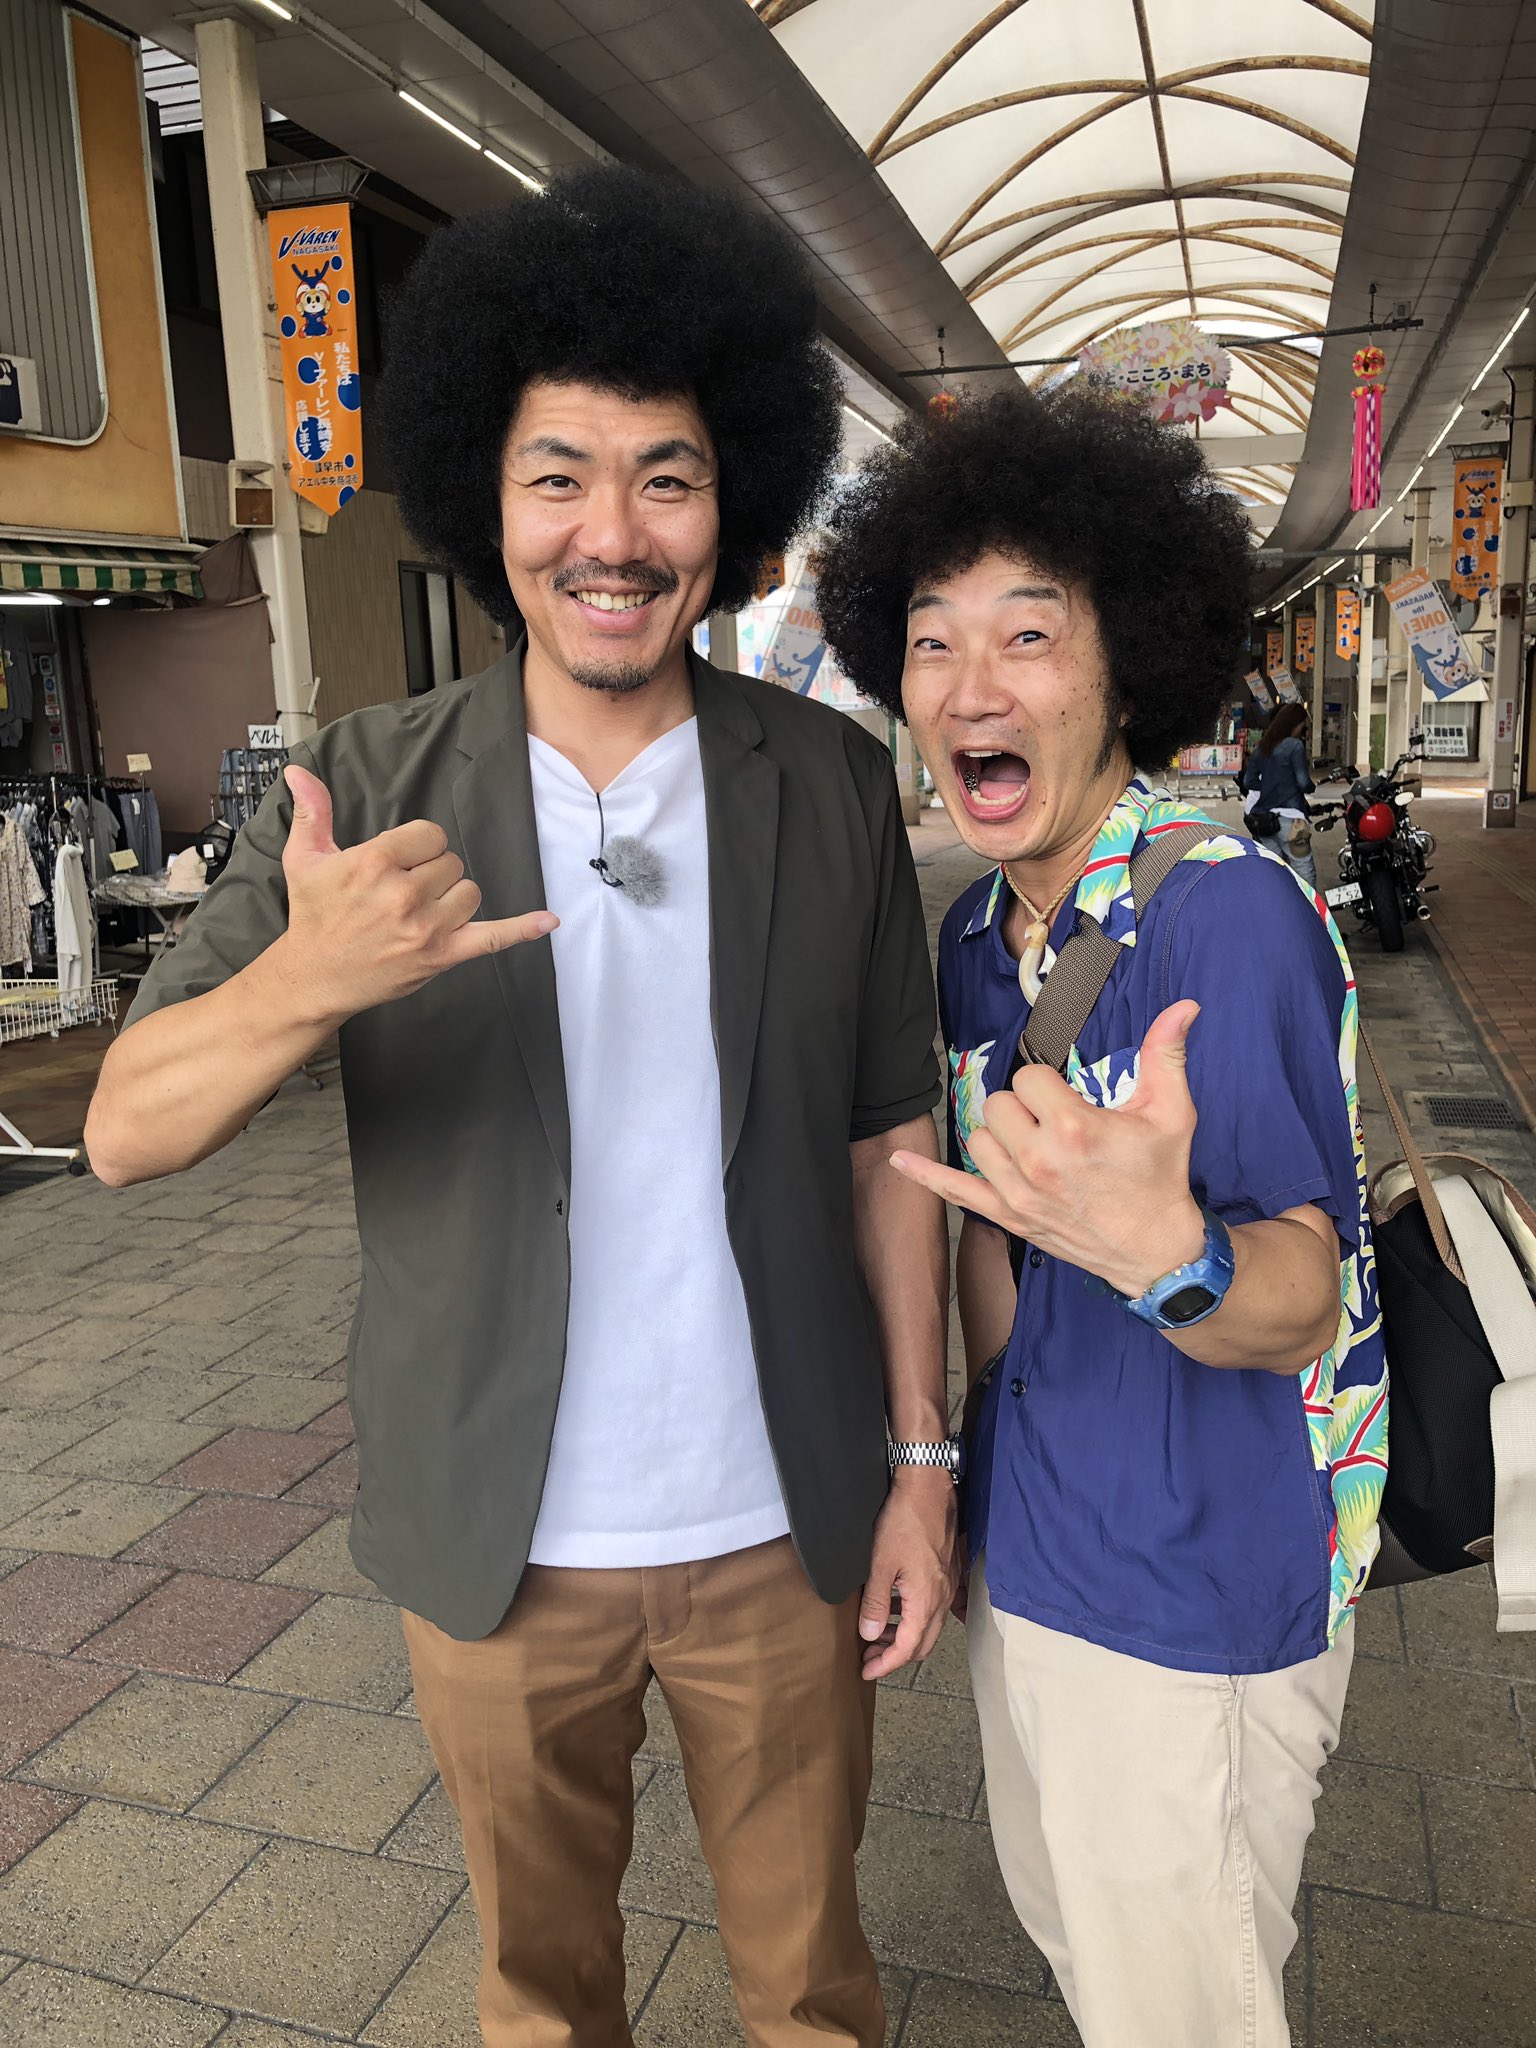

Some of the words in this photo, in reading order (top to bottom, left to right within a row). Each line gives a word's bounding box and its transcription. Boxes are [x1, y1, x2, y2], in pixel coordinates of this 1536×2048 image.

[292, 244, 339, 256] NAGASAKI
[333, 342, 352, 386] 私たちは
[251, 727, 280, 744] ベルト
